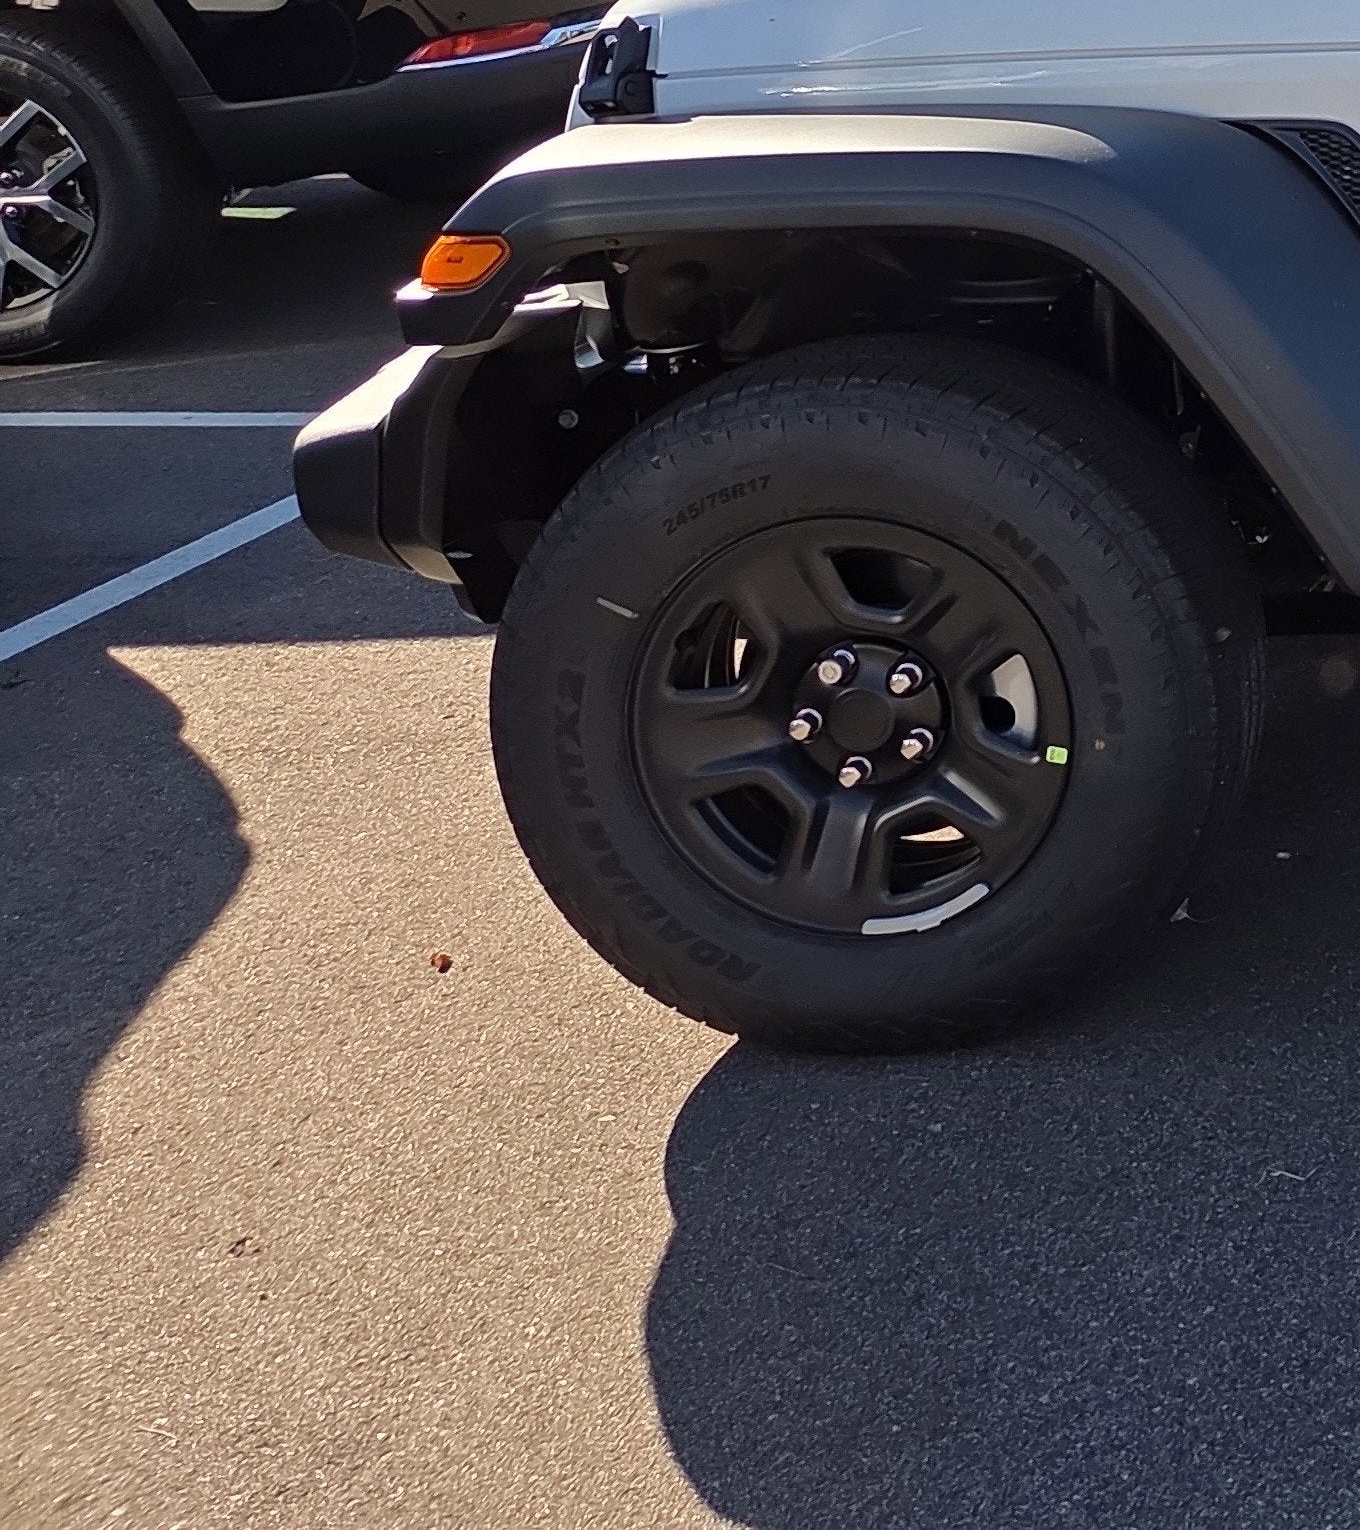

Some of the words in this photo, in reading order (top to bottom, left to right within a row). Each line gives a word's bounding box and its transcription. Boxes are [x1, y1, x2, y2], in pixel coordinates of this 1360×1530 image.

[661, 473, 773, 537] 245/75R17
[990, 519, 1127, 736] NEXEN
[574, 819, 763, 984] ROADIAN
